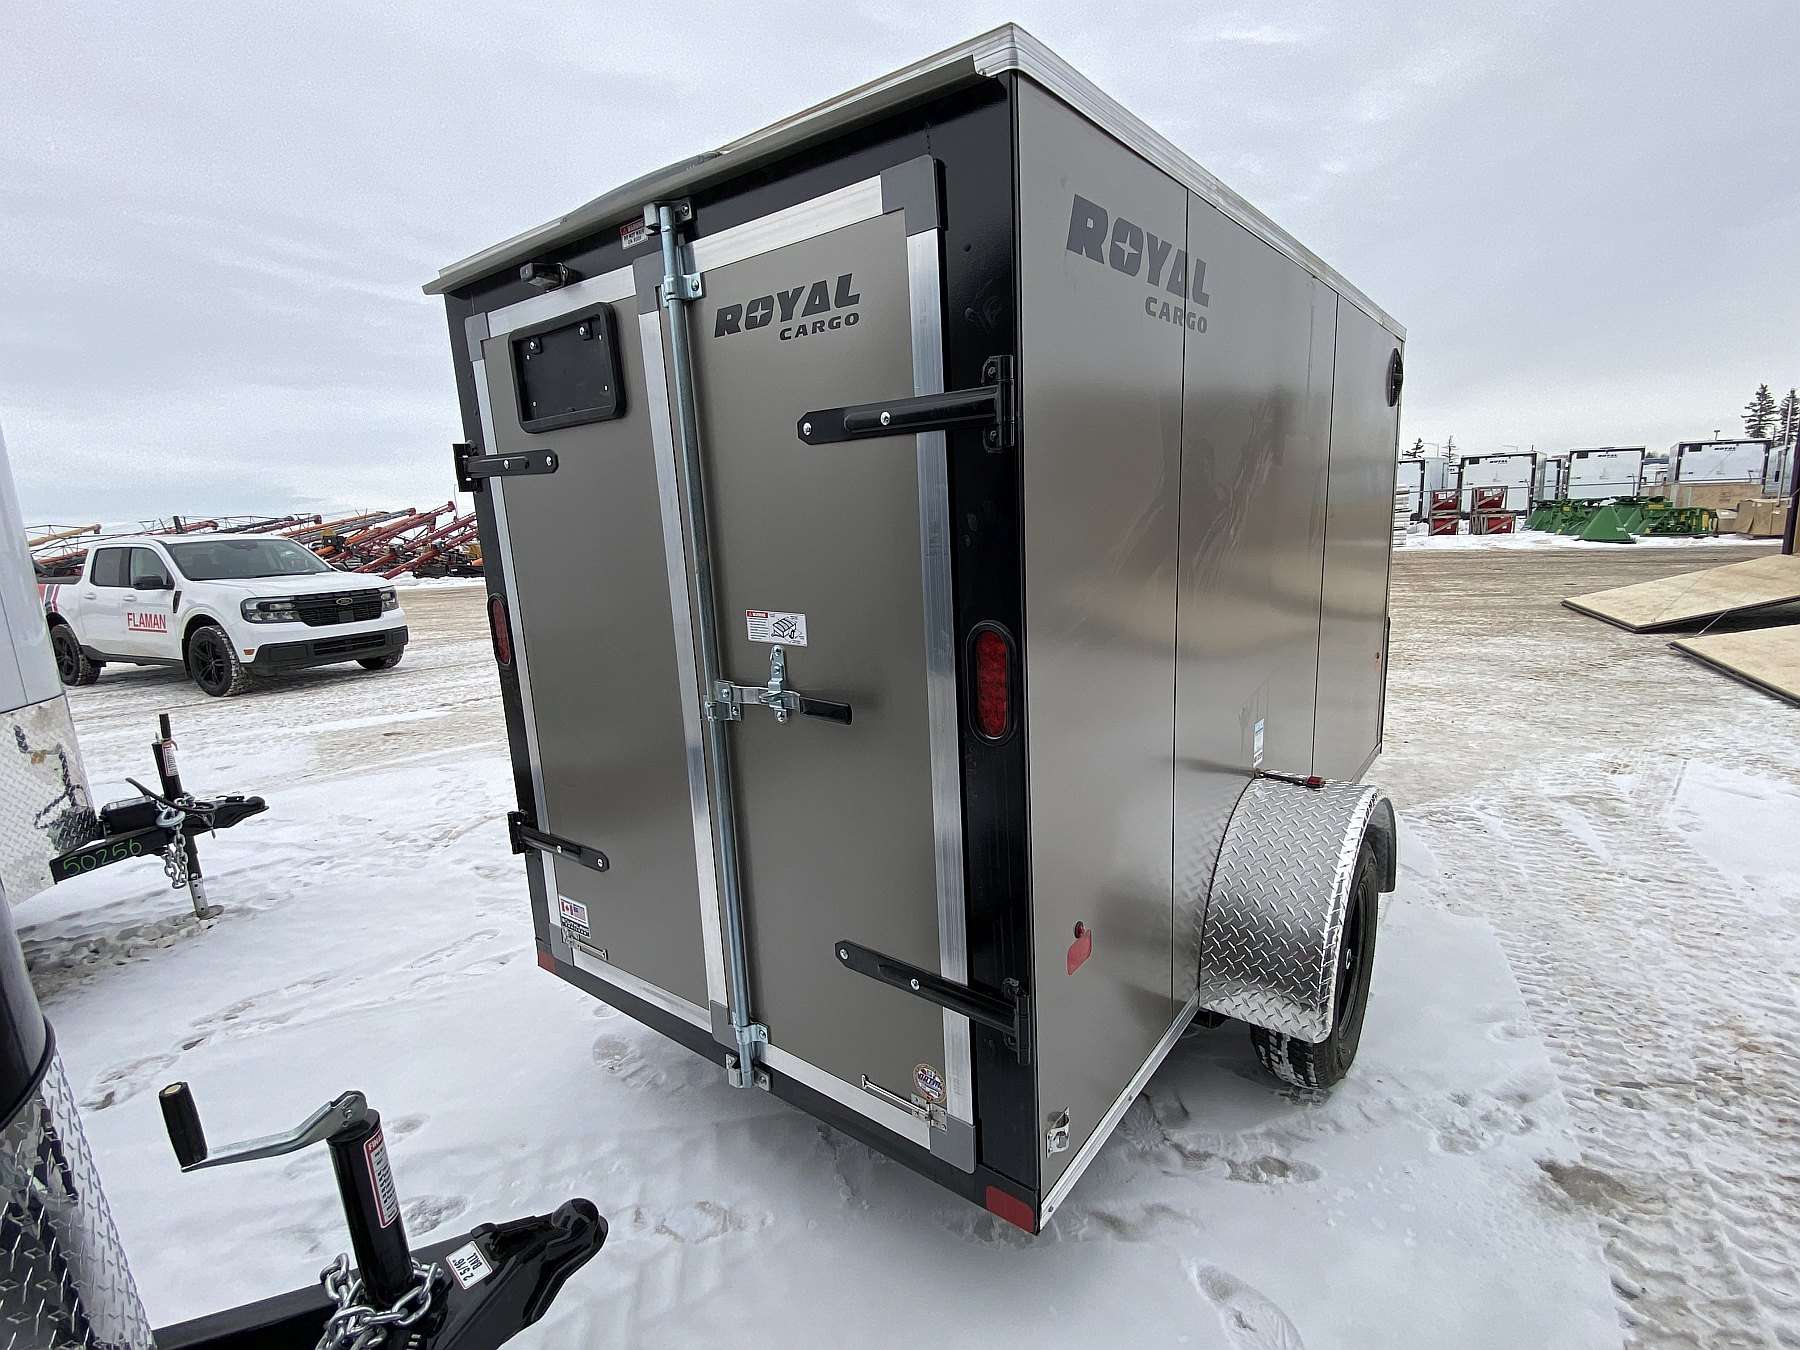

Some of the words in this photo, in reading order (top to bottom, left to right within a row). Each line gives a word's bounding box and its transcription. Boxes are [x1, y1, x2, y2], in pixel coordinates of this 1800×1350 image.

[1066, 194, 1210, 308] ROYAL
[714, 273, 861, 338] ROYAL
[1145, 296, 1207, 334] CARGO
[779, 313, 860, 341] CARGO
[127, 612, 166, 629] FLAMAN
[63, 839, 143, 876] 50256
[463, 1272, 474, 1281] 2
[467, 1252, 482, 1270] BALL
